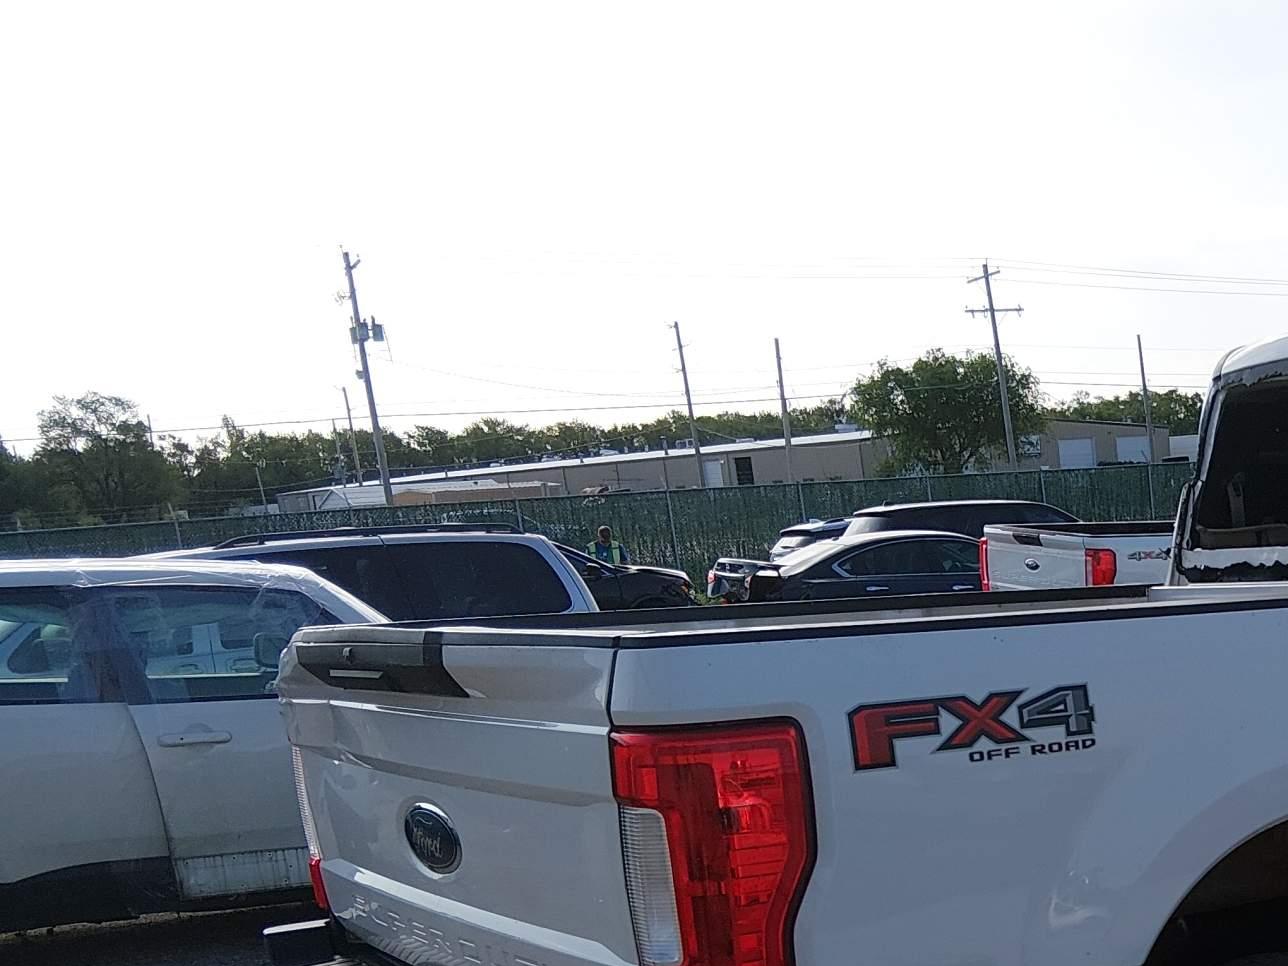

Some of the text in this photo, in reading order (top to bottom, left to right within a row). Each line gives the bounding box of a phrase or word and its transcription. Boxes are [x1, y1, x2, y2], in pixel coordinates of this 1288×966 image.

[847, 684, 1096, 773] FX4
[968, 738, 1097, 763] OFF ROAD
